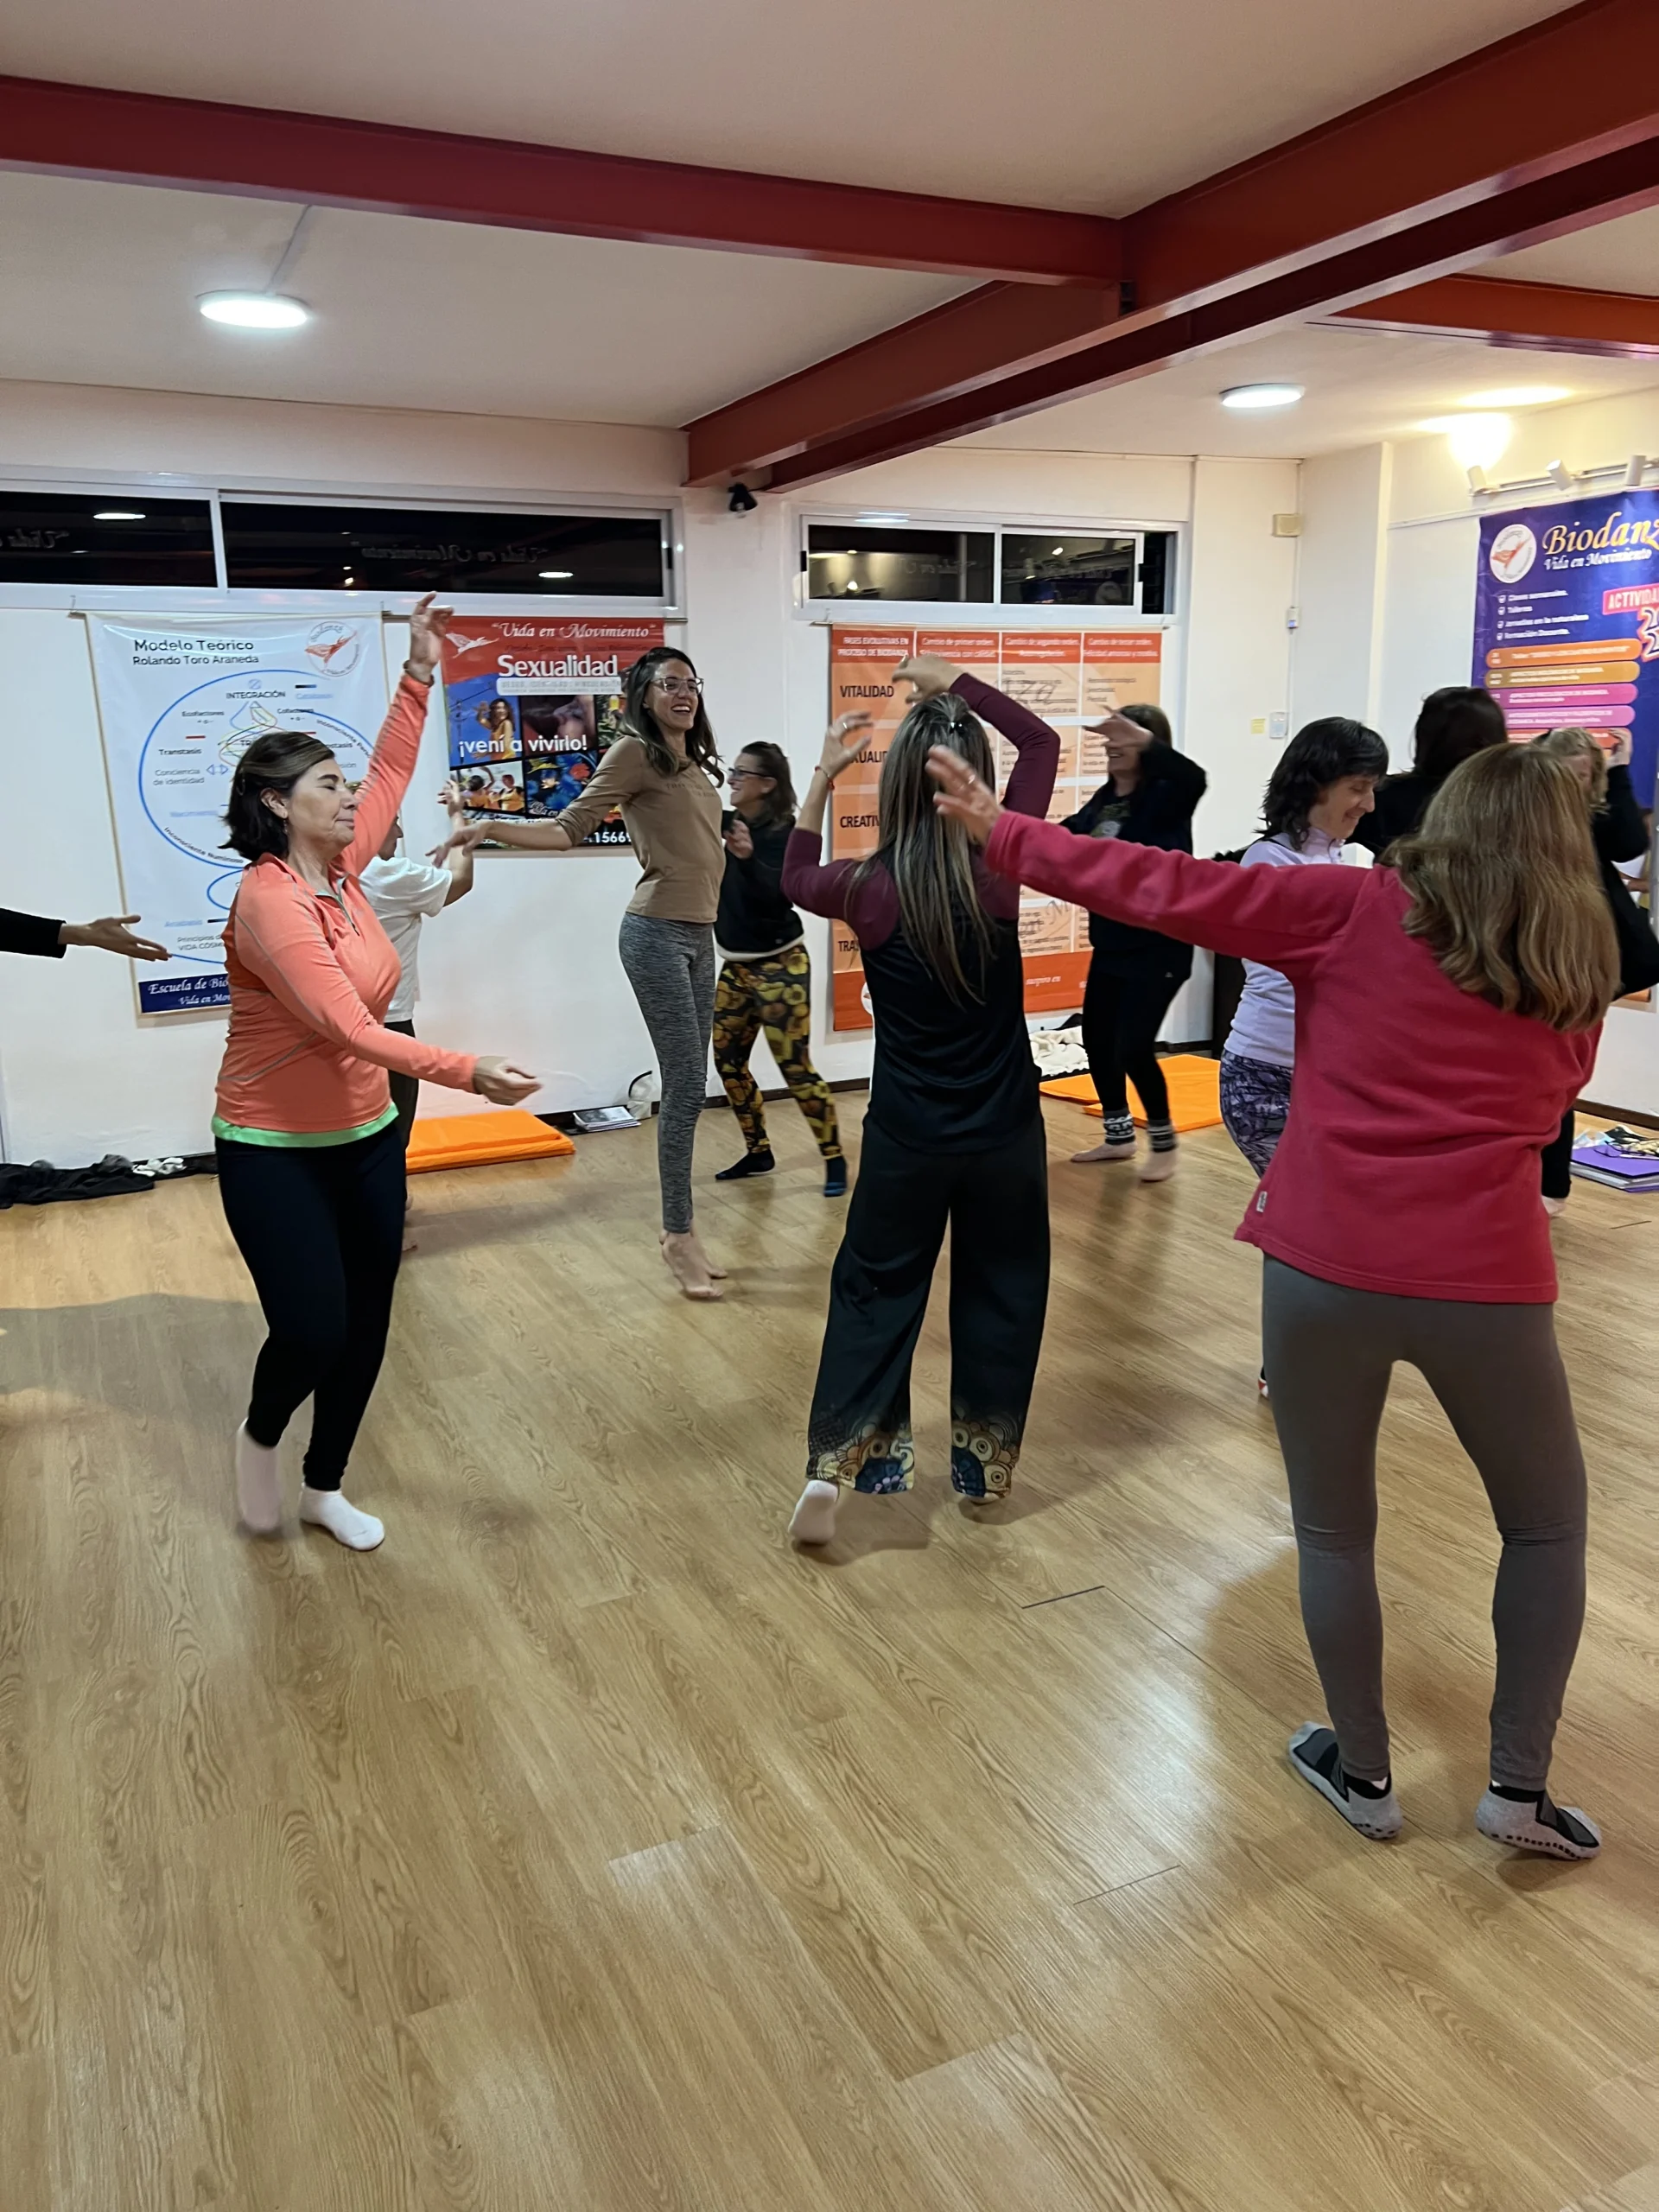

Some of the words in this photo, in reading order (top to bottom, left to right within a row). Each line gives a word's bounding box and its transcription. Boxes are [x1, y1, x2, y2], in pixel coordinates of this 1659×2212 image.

[1608, 588, 1659, 610] ACTIVIDA
[539, 628, 555, 638] en
[134, 639, 193, 652] Modelo
[195, 639, 254, 652] Teórico
[132, 656, 181, 665] Rolando
[182, 655, 210, 664] Toro
[212, 655, 259, 664] Araneda
[497, 654, 618, 677] Sexualidad
[840, 685, 894, 698] VITALIDAD
[459, 734, 505, 758] ¡vení
[510, 740, 523, 753] a
[528, 734, 588, 752] vivirlo!
[148, 979, 191, 995] Escuela
[194, 977, 207, 990] de
[178, 995, 200, 1005] Vida
